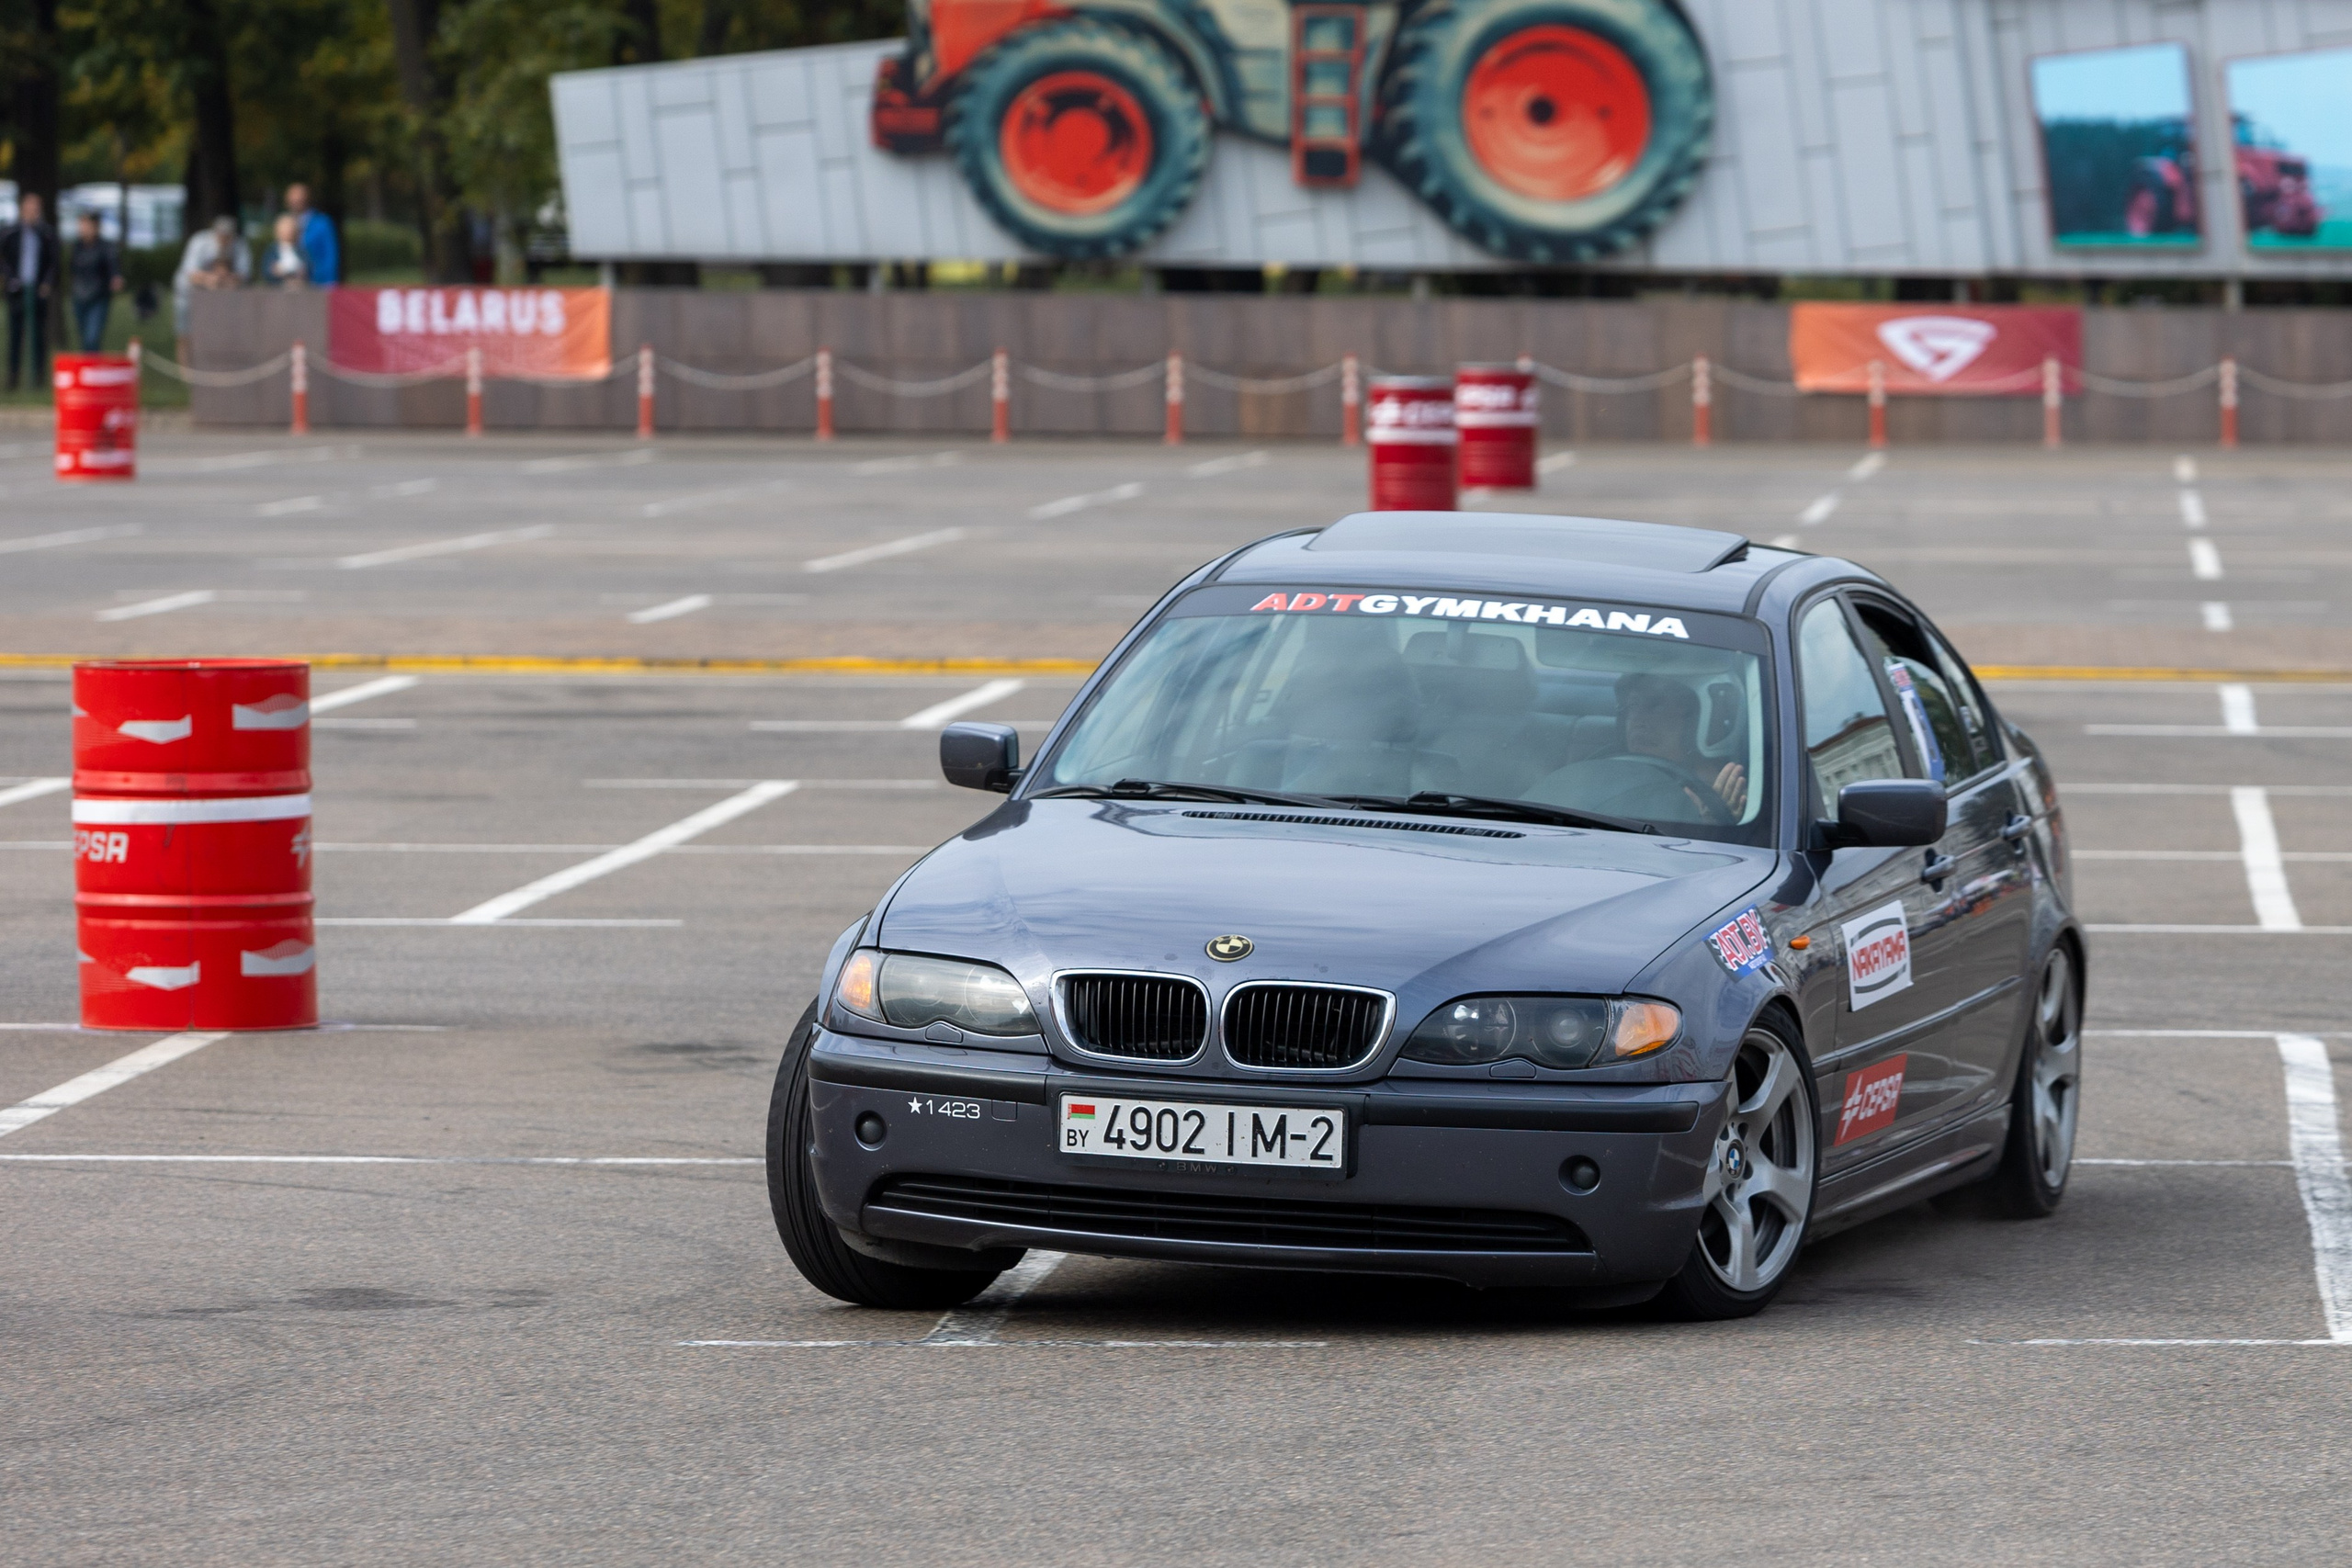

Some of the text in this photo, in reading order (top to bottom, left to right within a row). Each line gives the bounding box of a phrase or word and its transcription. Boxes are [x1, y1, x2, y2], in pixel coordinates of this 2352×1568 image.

[377, 288, 565, 334] BELARUS
[1250, 592, 1690, 639] ADTGYMKHANA
[1714, 908, 1769, 971] ADT.BY
[1851, 931, 1907, 982] NAKAYAMA
[926, 1100, 980, 1119] 1423
[1859, 1073, 1903, 1121] CEPSA
[1067, 1128, 1090, 1147] BY
[1103, 1103, 1205, 1155] 4902
[1176, 1161, 1217, 1174] BMW
